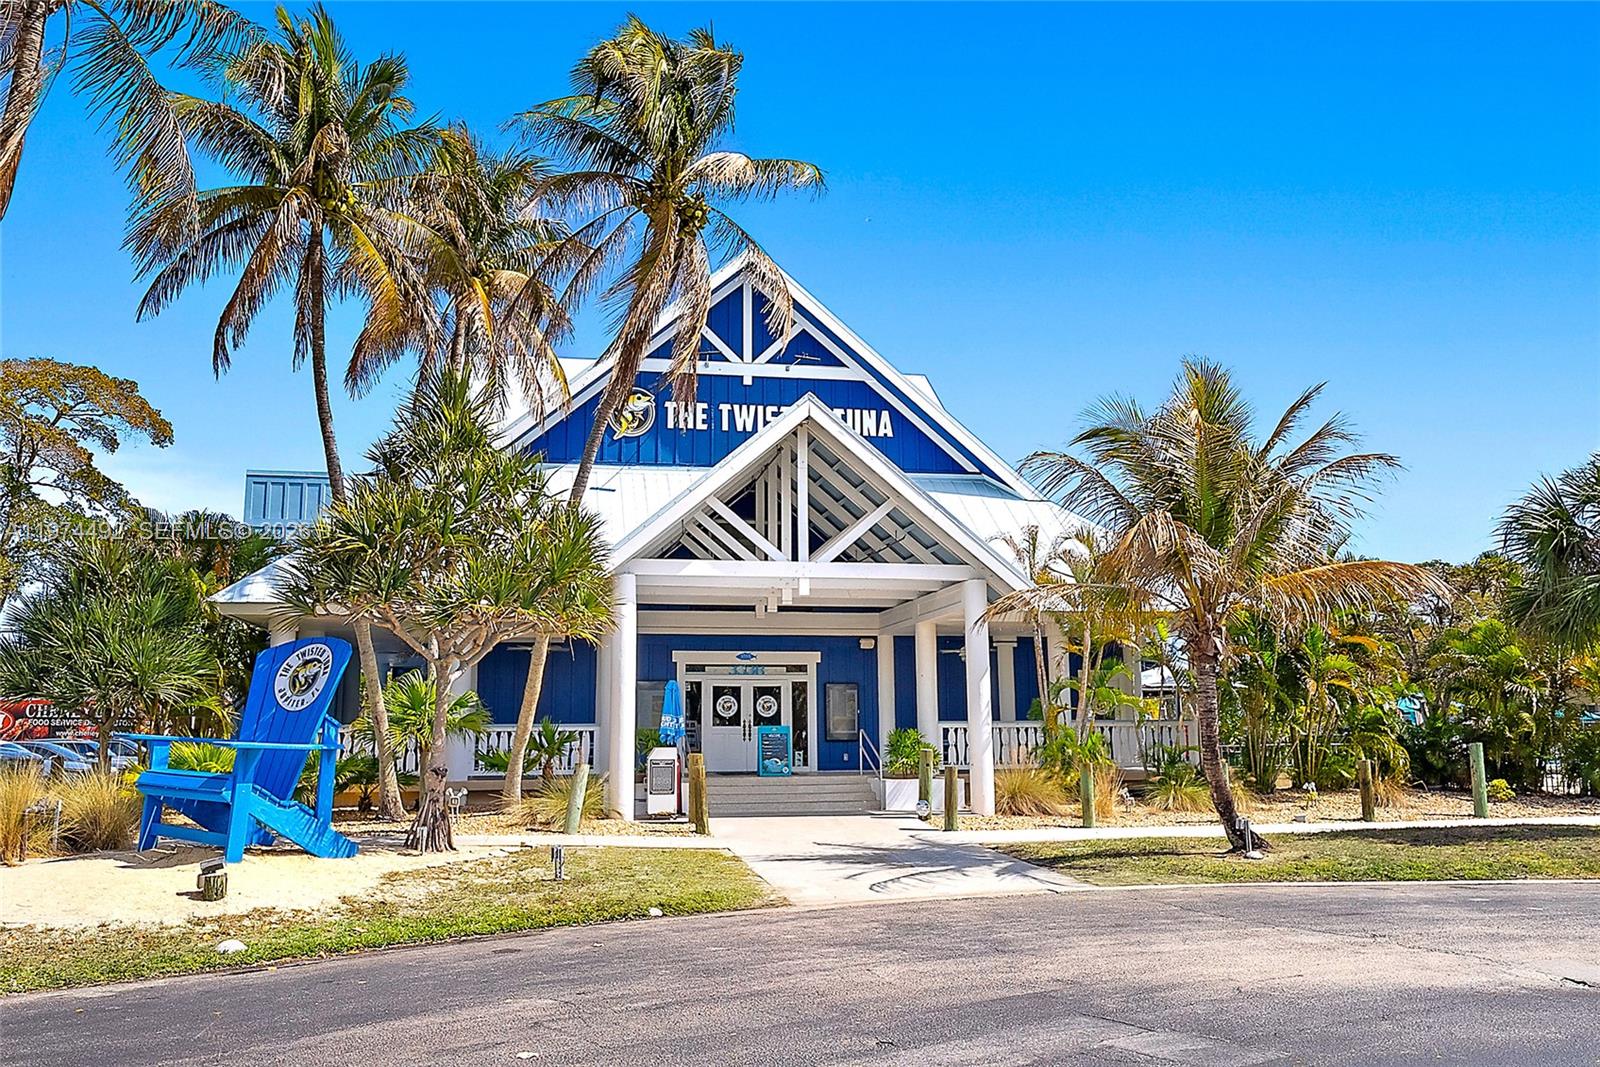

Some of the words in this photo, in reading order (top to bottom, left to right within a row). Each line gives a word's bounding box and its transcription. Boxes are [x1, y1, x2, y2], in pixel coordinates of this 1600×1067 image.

[664, 401, 708, 430] THE
[279, 662, 294, 678] THE
[296, 646, 327, 661] TWISTED
